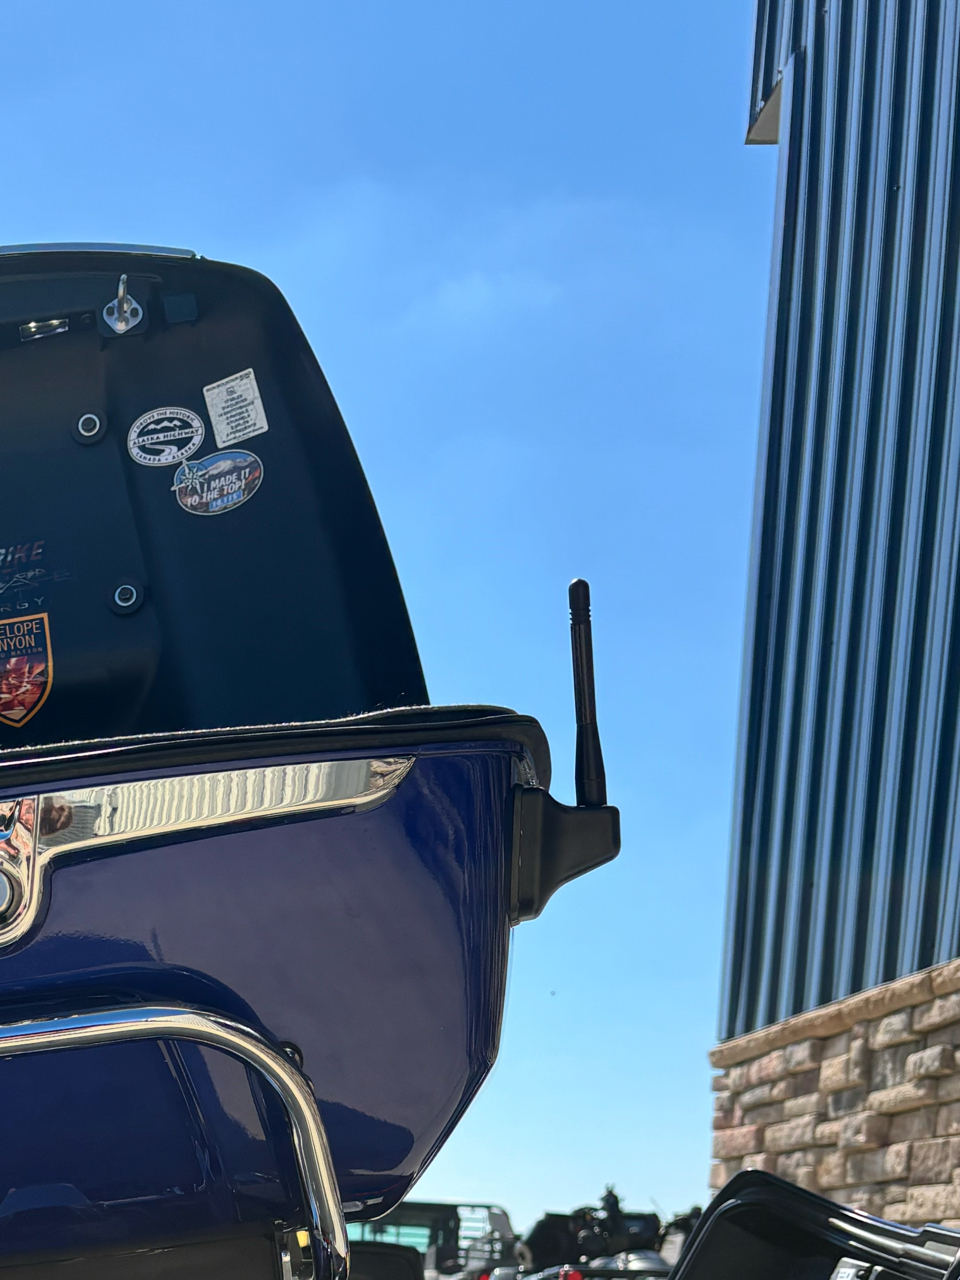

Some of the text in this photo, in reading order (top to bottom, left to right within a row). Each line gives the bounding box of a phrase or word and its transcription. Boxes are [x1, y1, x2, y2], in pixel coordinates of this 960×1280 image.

[136, 415, 155, 430] DROVE
[168, 411, 196, 424] HISTORIC
[132, 428, 200, 446] ALASKA HIGHWAY
[135, 442, 197, 462] CANADA ALASKA
[204, 468, 250, 492] I MADE IT
[187, 479, 245, 507] TO THE TOP!
[11, 647, 43, 656] NATION
